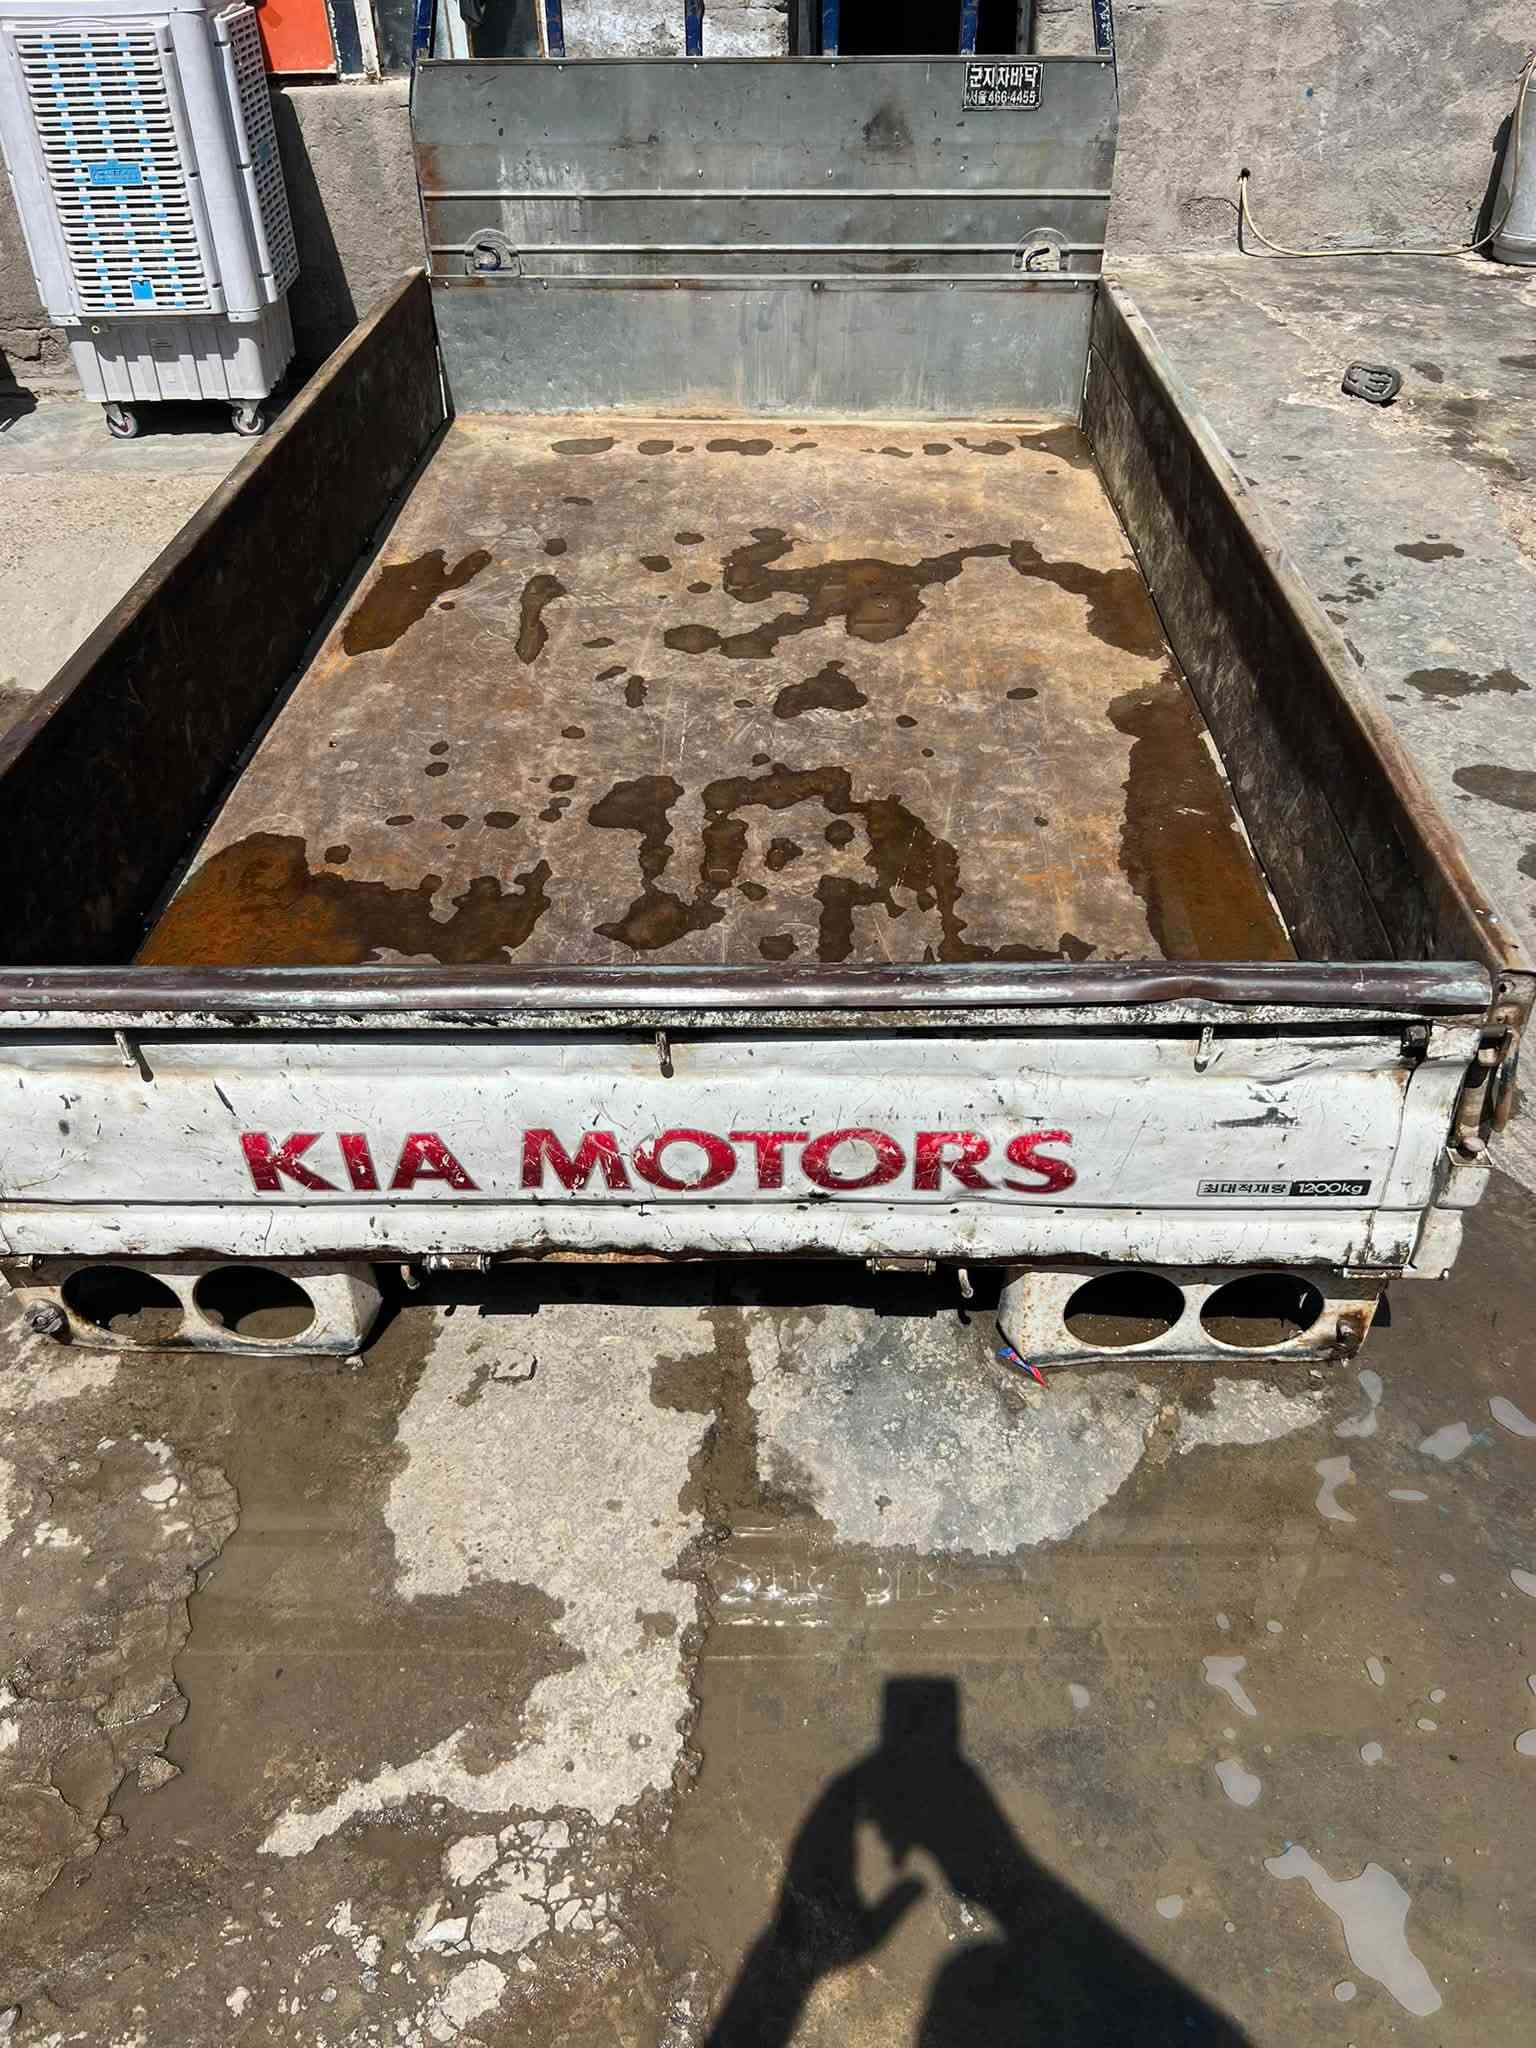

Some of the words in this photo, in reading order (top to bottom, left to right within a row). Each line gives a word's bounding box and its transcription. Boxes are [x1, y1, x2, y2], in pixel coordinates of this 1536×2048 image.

[238, 1131, 482, 1192] KIA
[521, 1127, 1078, 1194] MOTORS
[1203, 1183, 1287, 1194] 최대적재량
[1299, 1182, 1364, 1195] 1200kg
